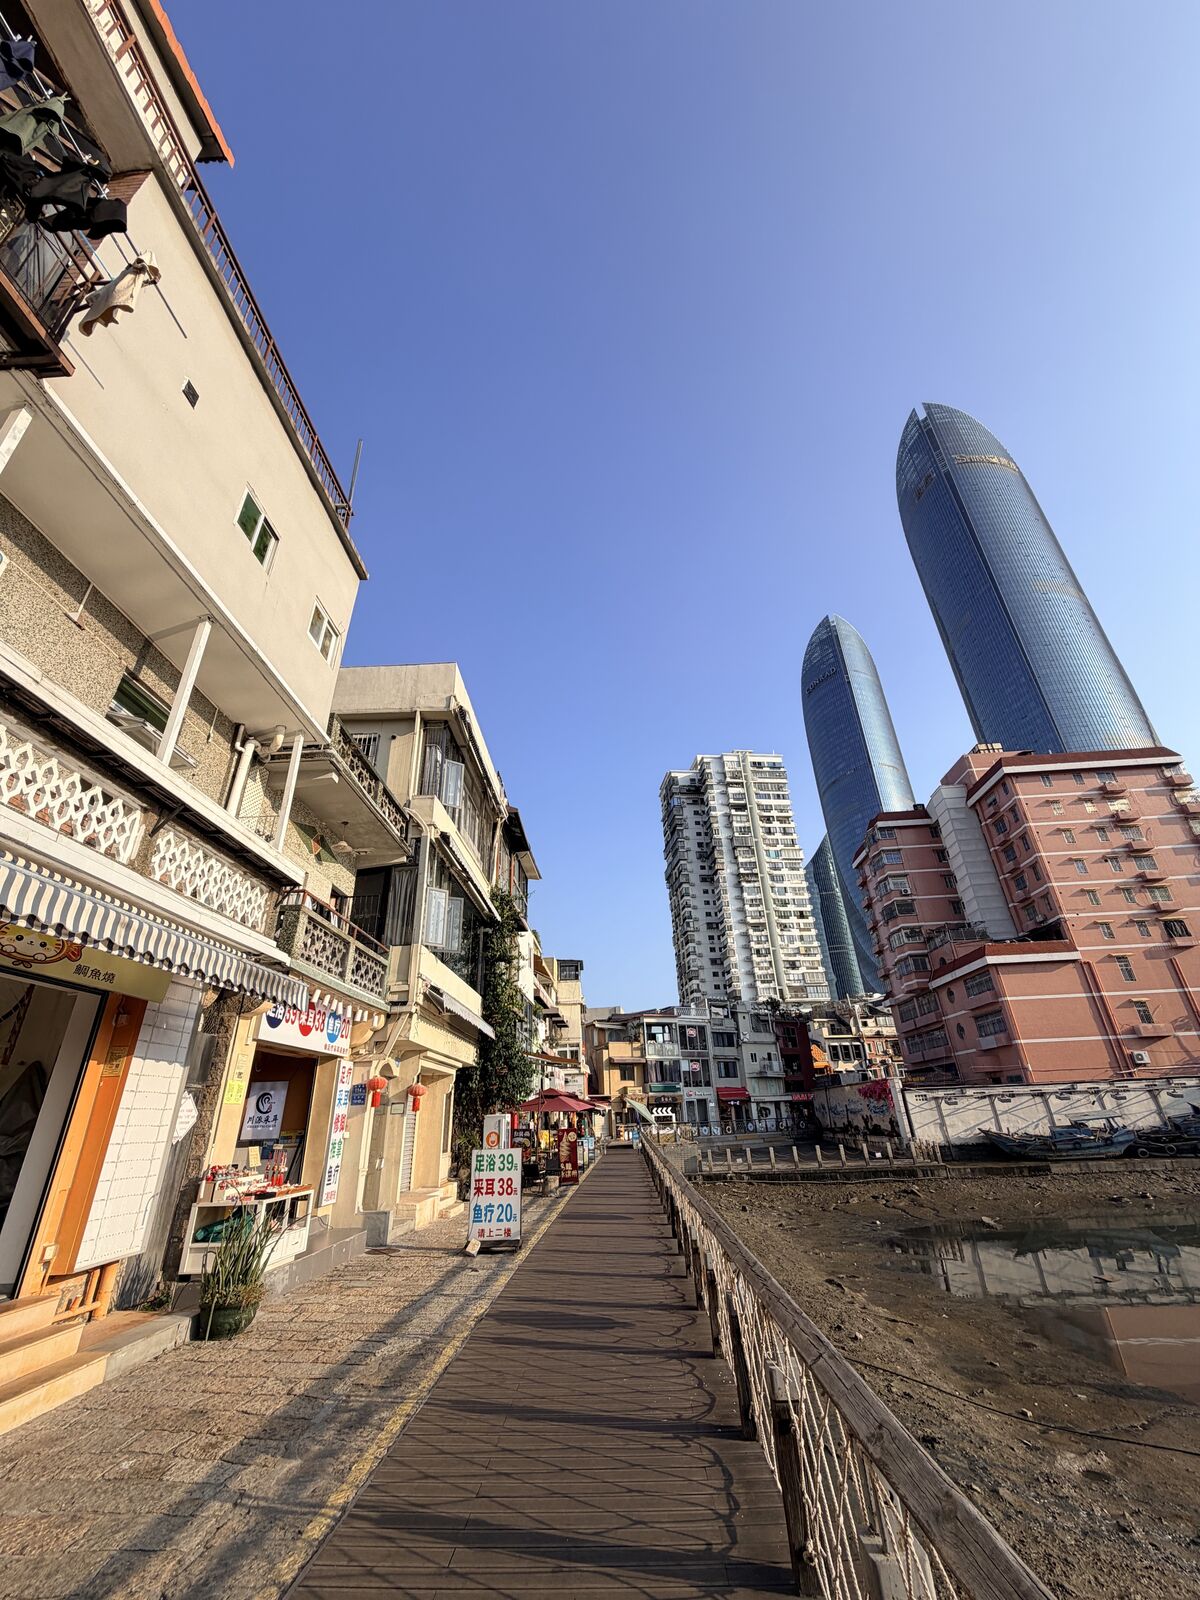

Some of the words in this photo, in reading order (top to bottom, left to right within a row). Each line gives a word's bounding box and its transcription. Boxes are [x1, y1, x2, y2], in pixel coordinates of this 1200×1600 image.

[806, 667, 836, 695] CONRAD
[73, 964, 116, 984] 鯛魚燒
[340, 1018, 350, 1039] 20
[474, 1153, 518, 1173] 足浴39元
[473, 1177, 518, 1197] 采耳38元
[472, 1203, 518, 1223] 鱼疗20元
[477, 1227, 512, 1238] 请上二楼
